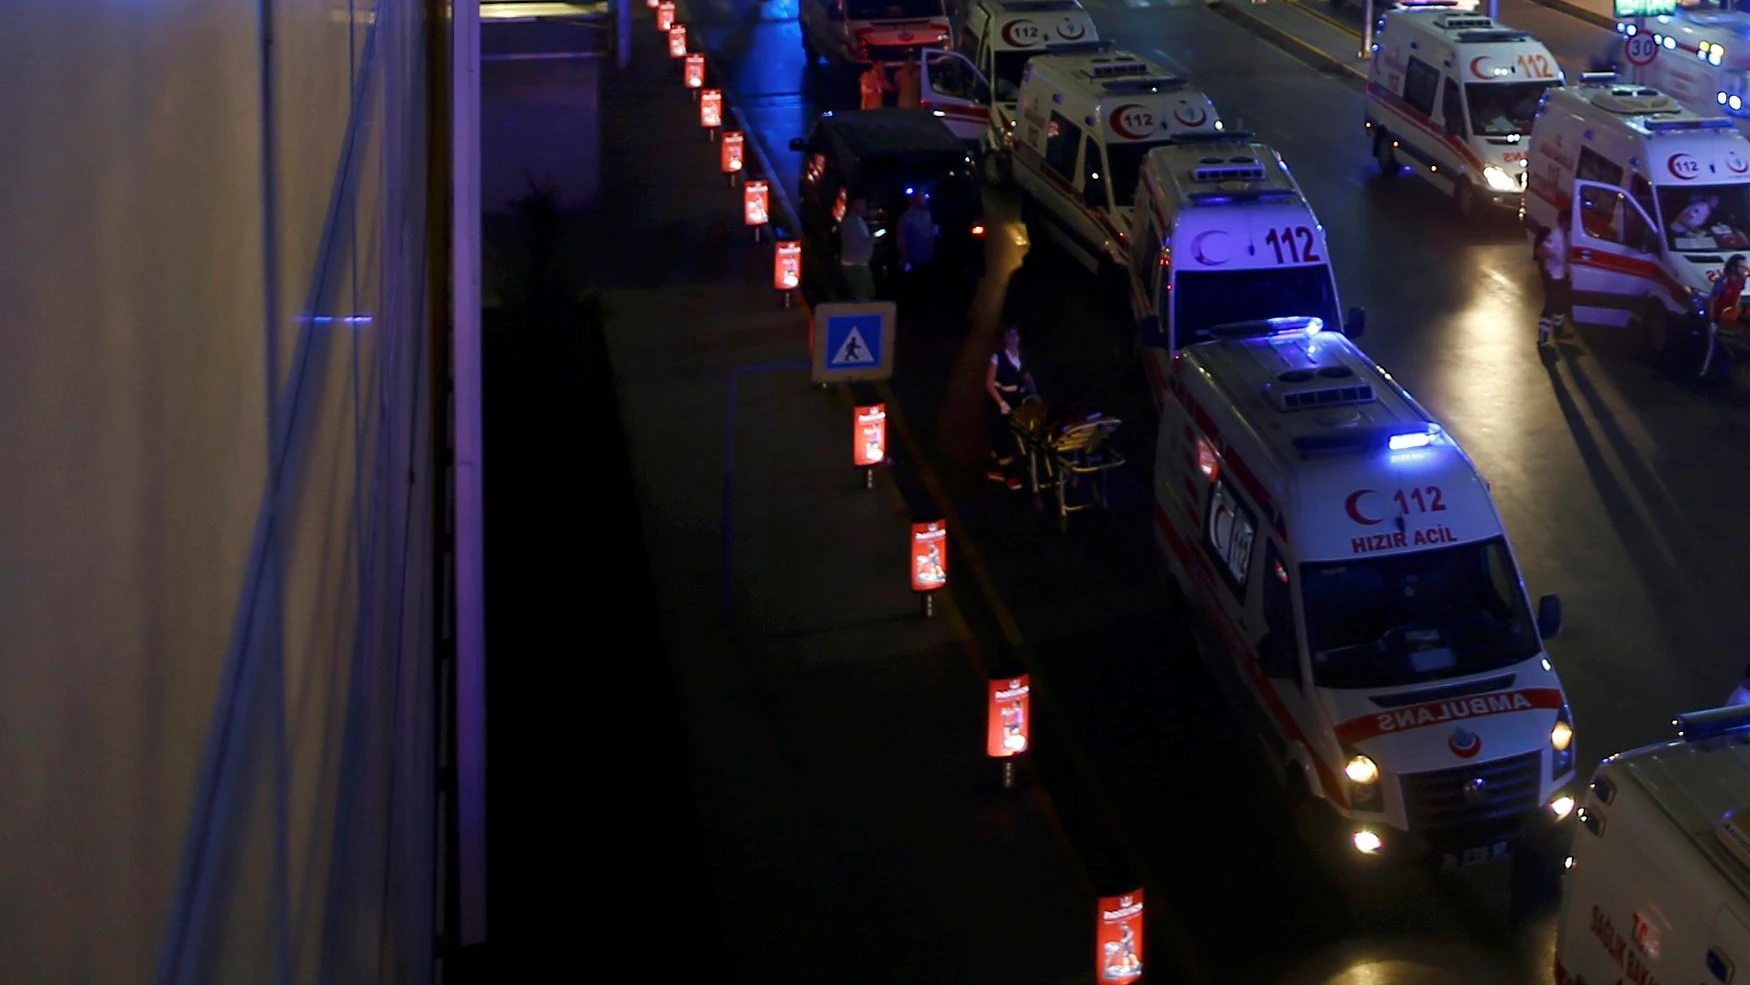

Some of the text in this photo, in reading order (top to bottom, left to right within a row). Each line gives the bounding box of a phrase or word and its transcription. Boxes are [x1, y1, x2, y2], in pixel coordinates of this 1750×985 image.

[1013, 25, 1038, 37] 112
[1631, 40, 1653, 56] 30
[1517, 54, 1553, 79] 112
[1122, 113, 1153, 127] 112
[1675, 160, 1700, 172] 112
[1265, 226, 1321, 264] 112
[1394, 485, 1447, 515] 112
[1351, 524, 1459, 553] HIZIR ACİL
